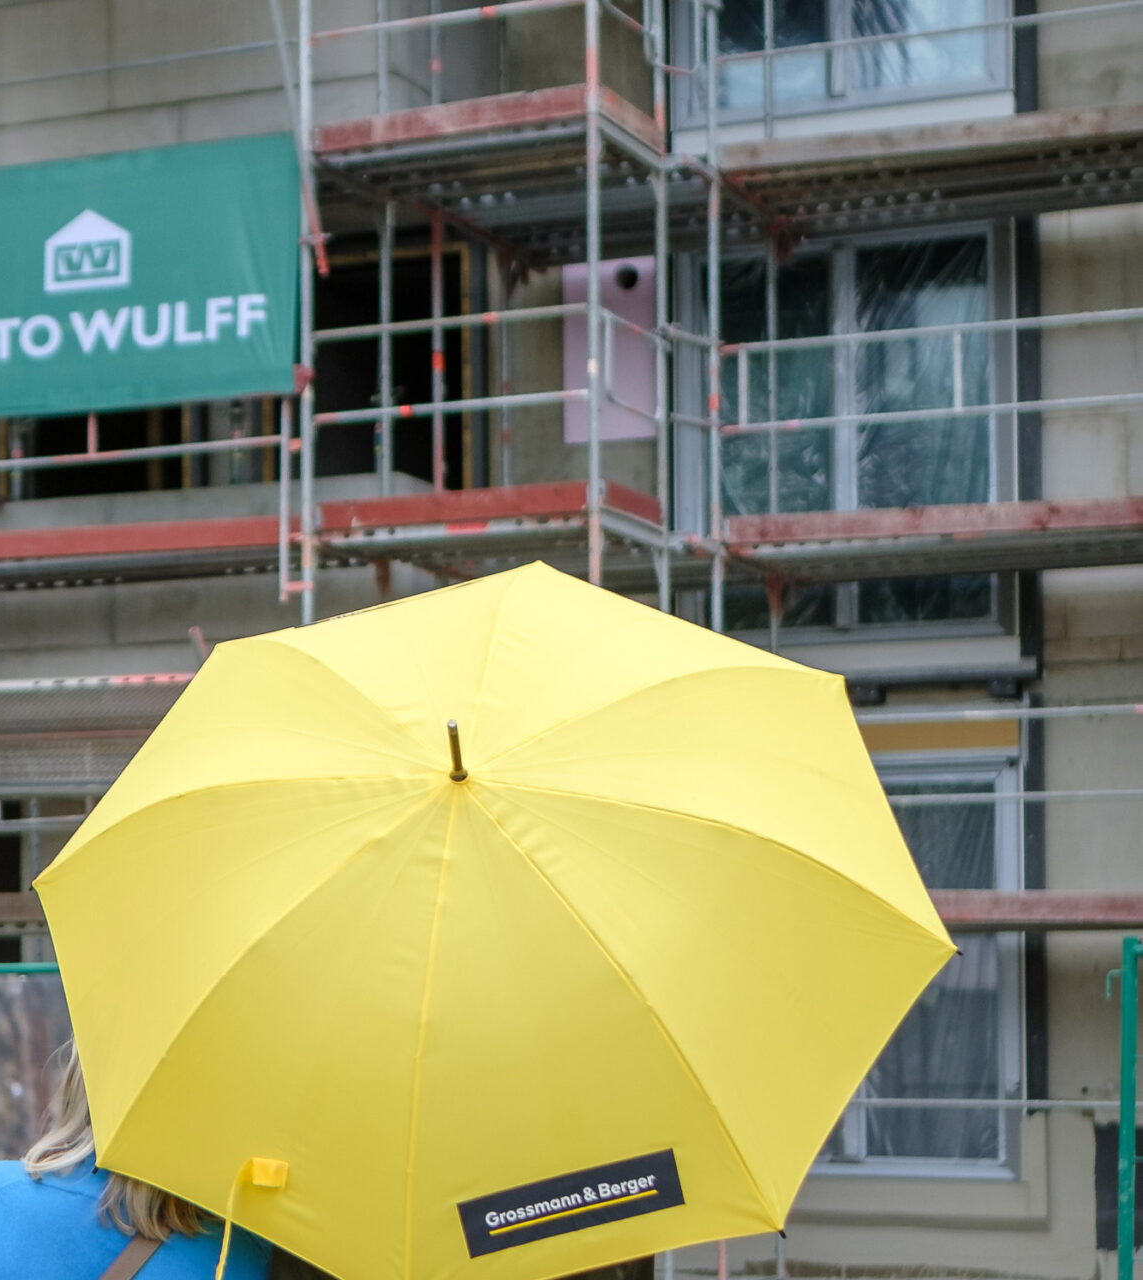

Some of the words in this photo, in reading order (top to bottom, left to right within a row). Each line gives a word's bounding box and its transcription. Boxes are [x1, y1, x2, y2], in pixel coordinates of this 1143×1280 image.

[69, 294, 266, 353] WULFF
[485, 1192, 582, 1227] Grossmann
[583, 1187, 597, 1202] &
[598, 1174, 657, 1199] Berger
